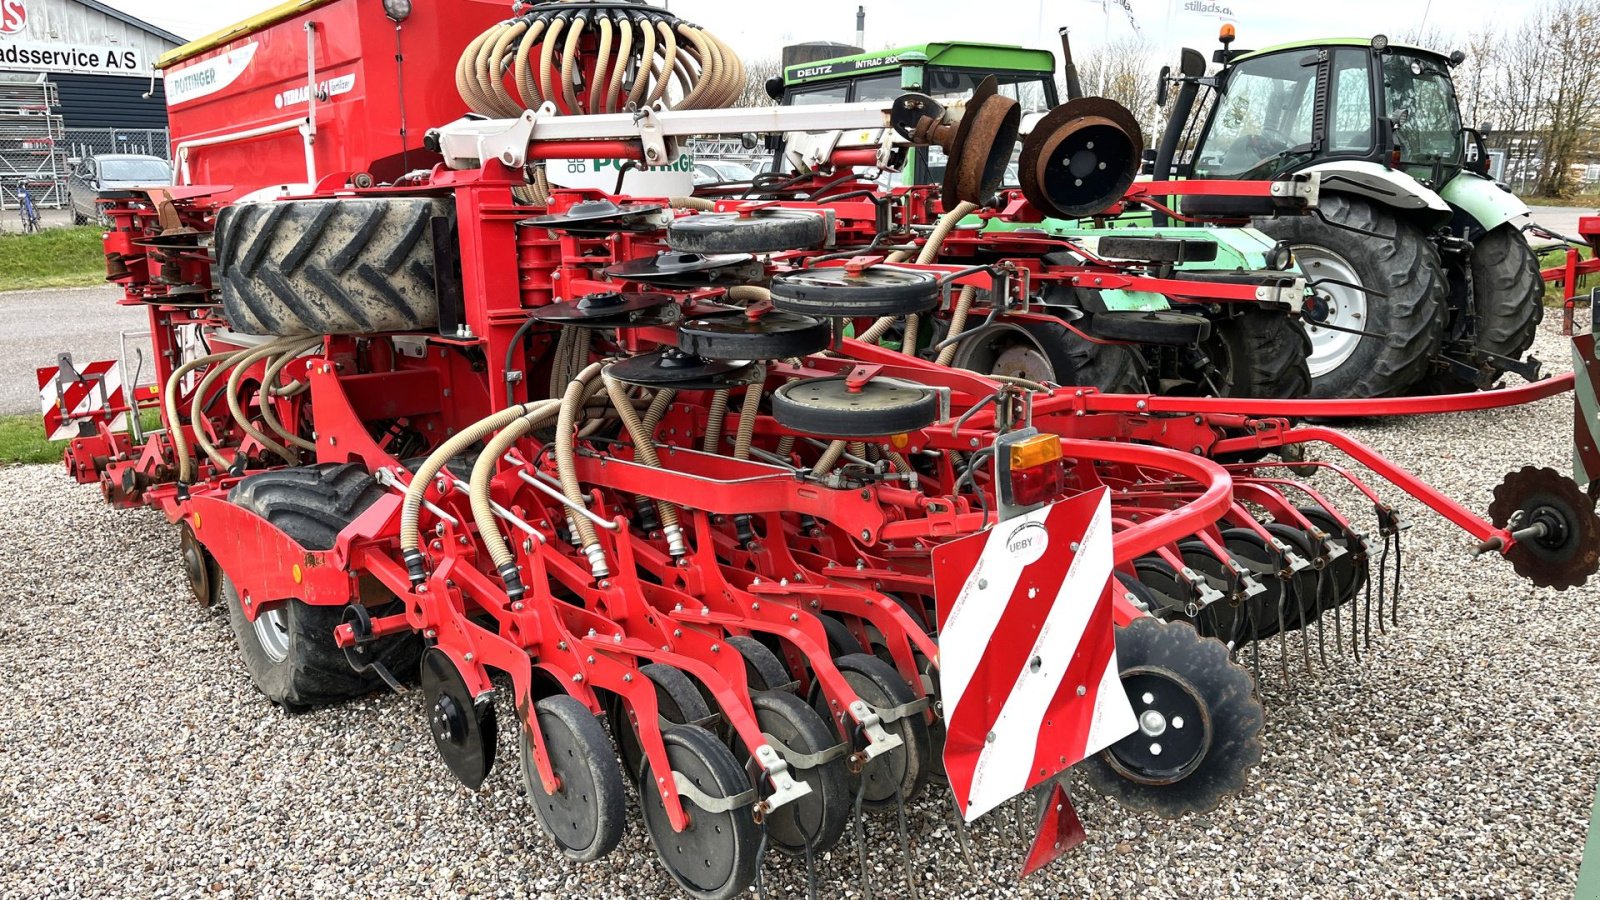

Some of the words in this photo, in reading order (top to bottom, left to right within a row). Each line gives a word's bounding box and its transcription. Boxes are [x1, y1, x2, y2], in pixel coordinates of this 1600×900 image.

[106, 50, 136, 69] A/S
[797, 65, 832, 77] DEUTZ
[855, 58, 882, 69] INTRAC
